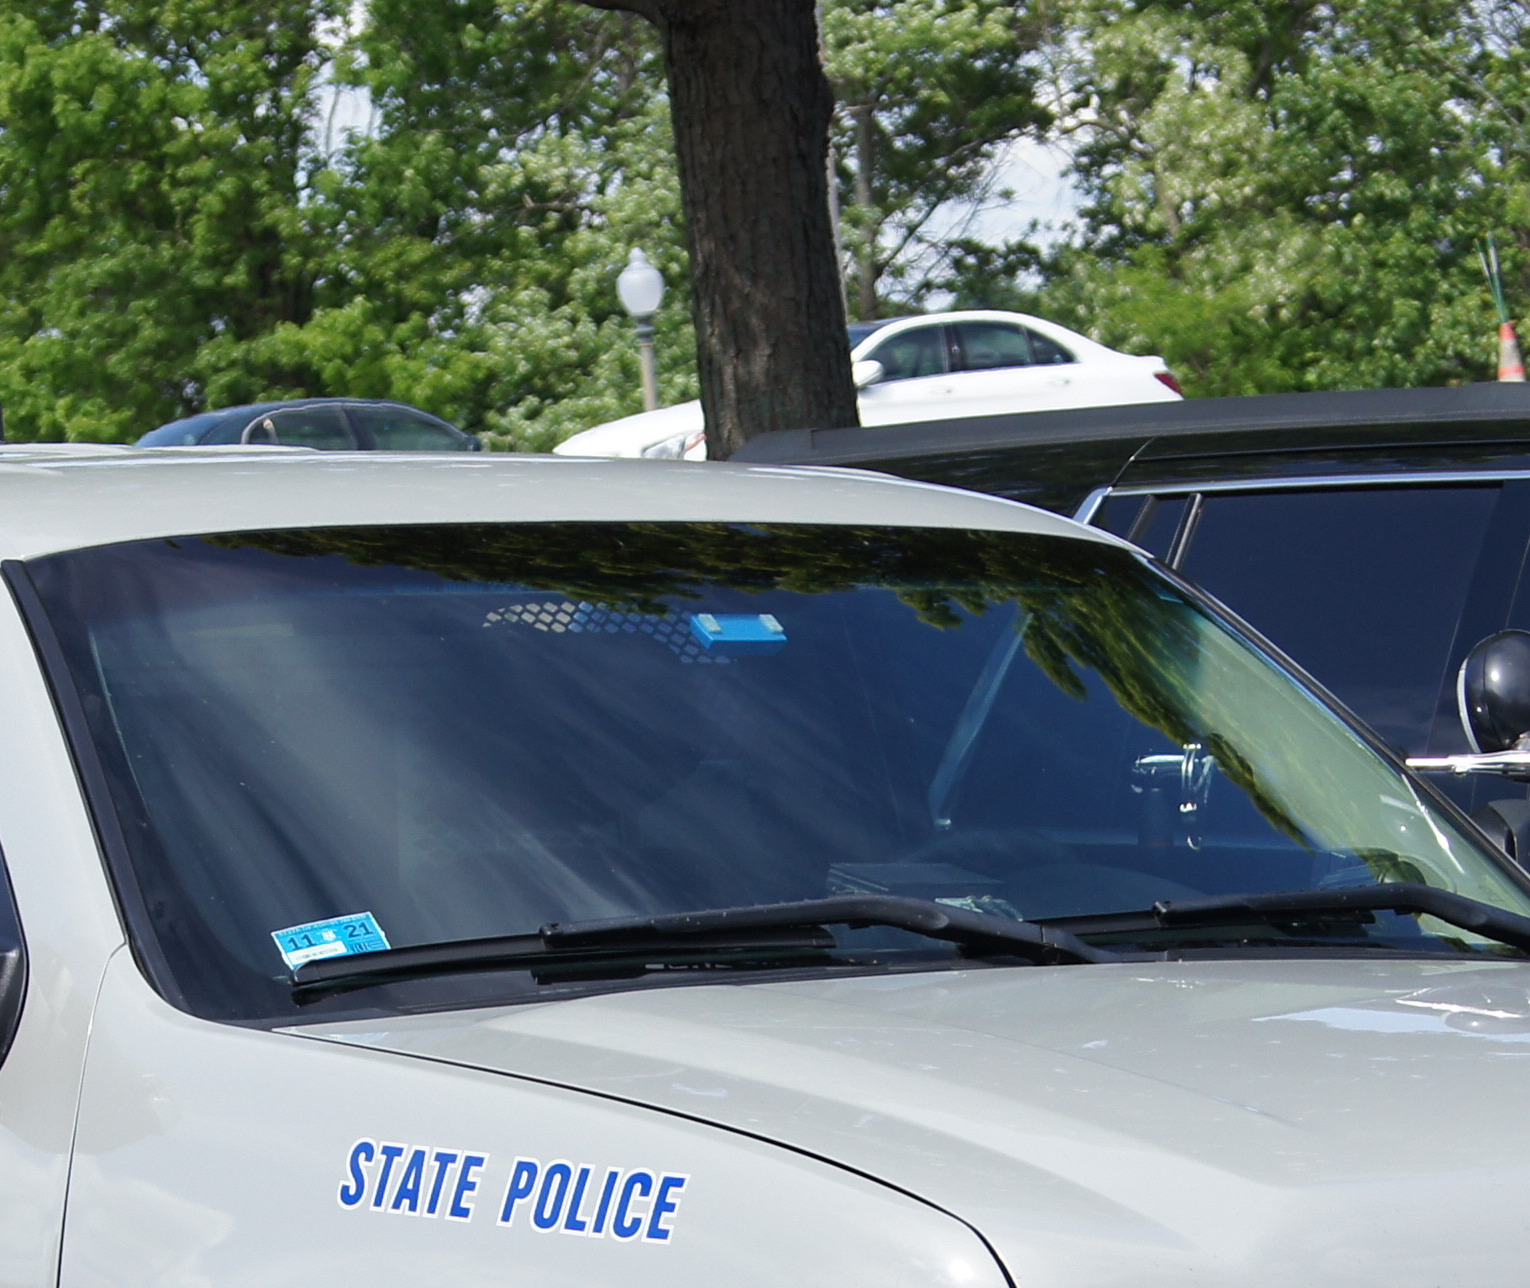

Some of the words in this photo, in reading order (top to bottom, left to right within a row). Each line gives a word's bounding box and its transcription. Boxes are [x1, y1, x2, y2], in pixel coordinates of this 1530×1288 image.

[287, 933, 317, 951] 11
[343, 921, 374, 938] 21
[337, 1137, 490, 1223] STATE
[496, 1156, 691, 1245] POLICE
